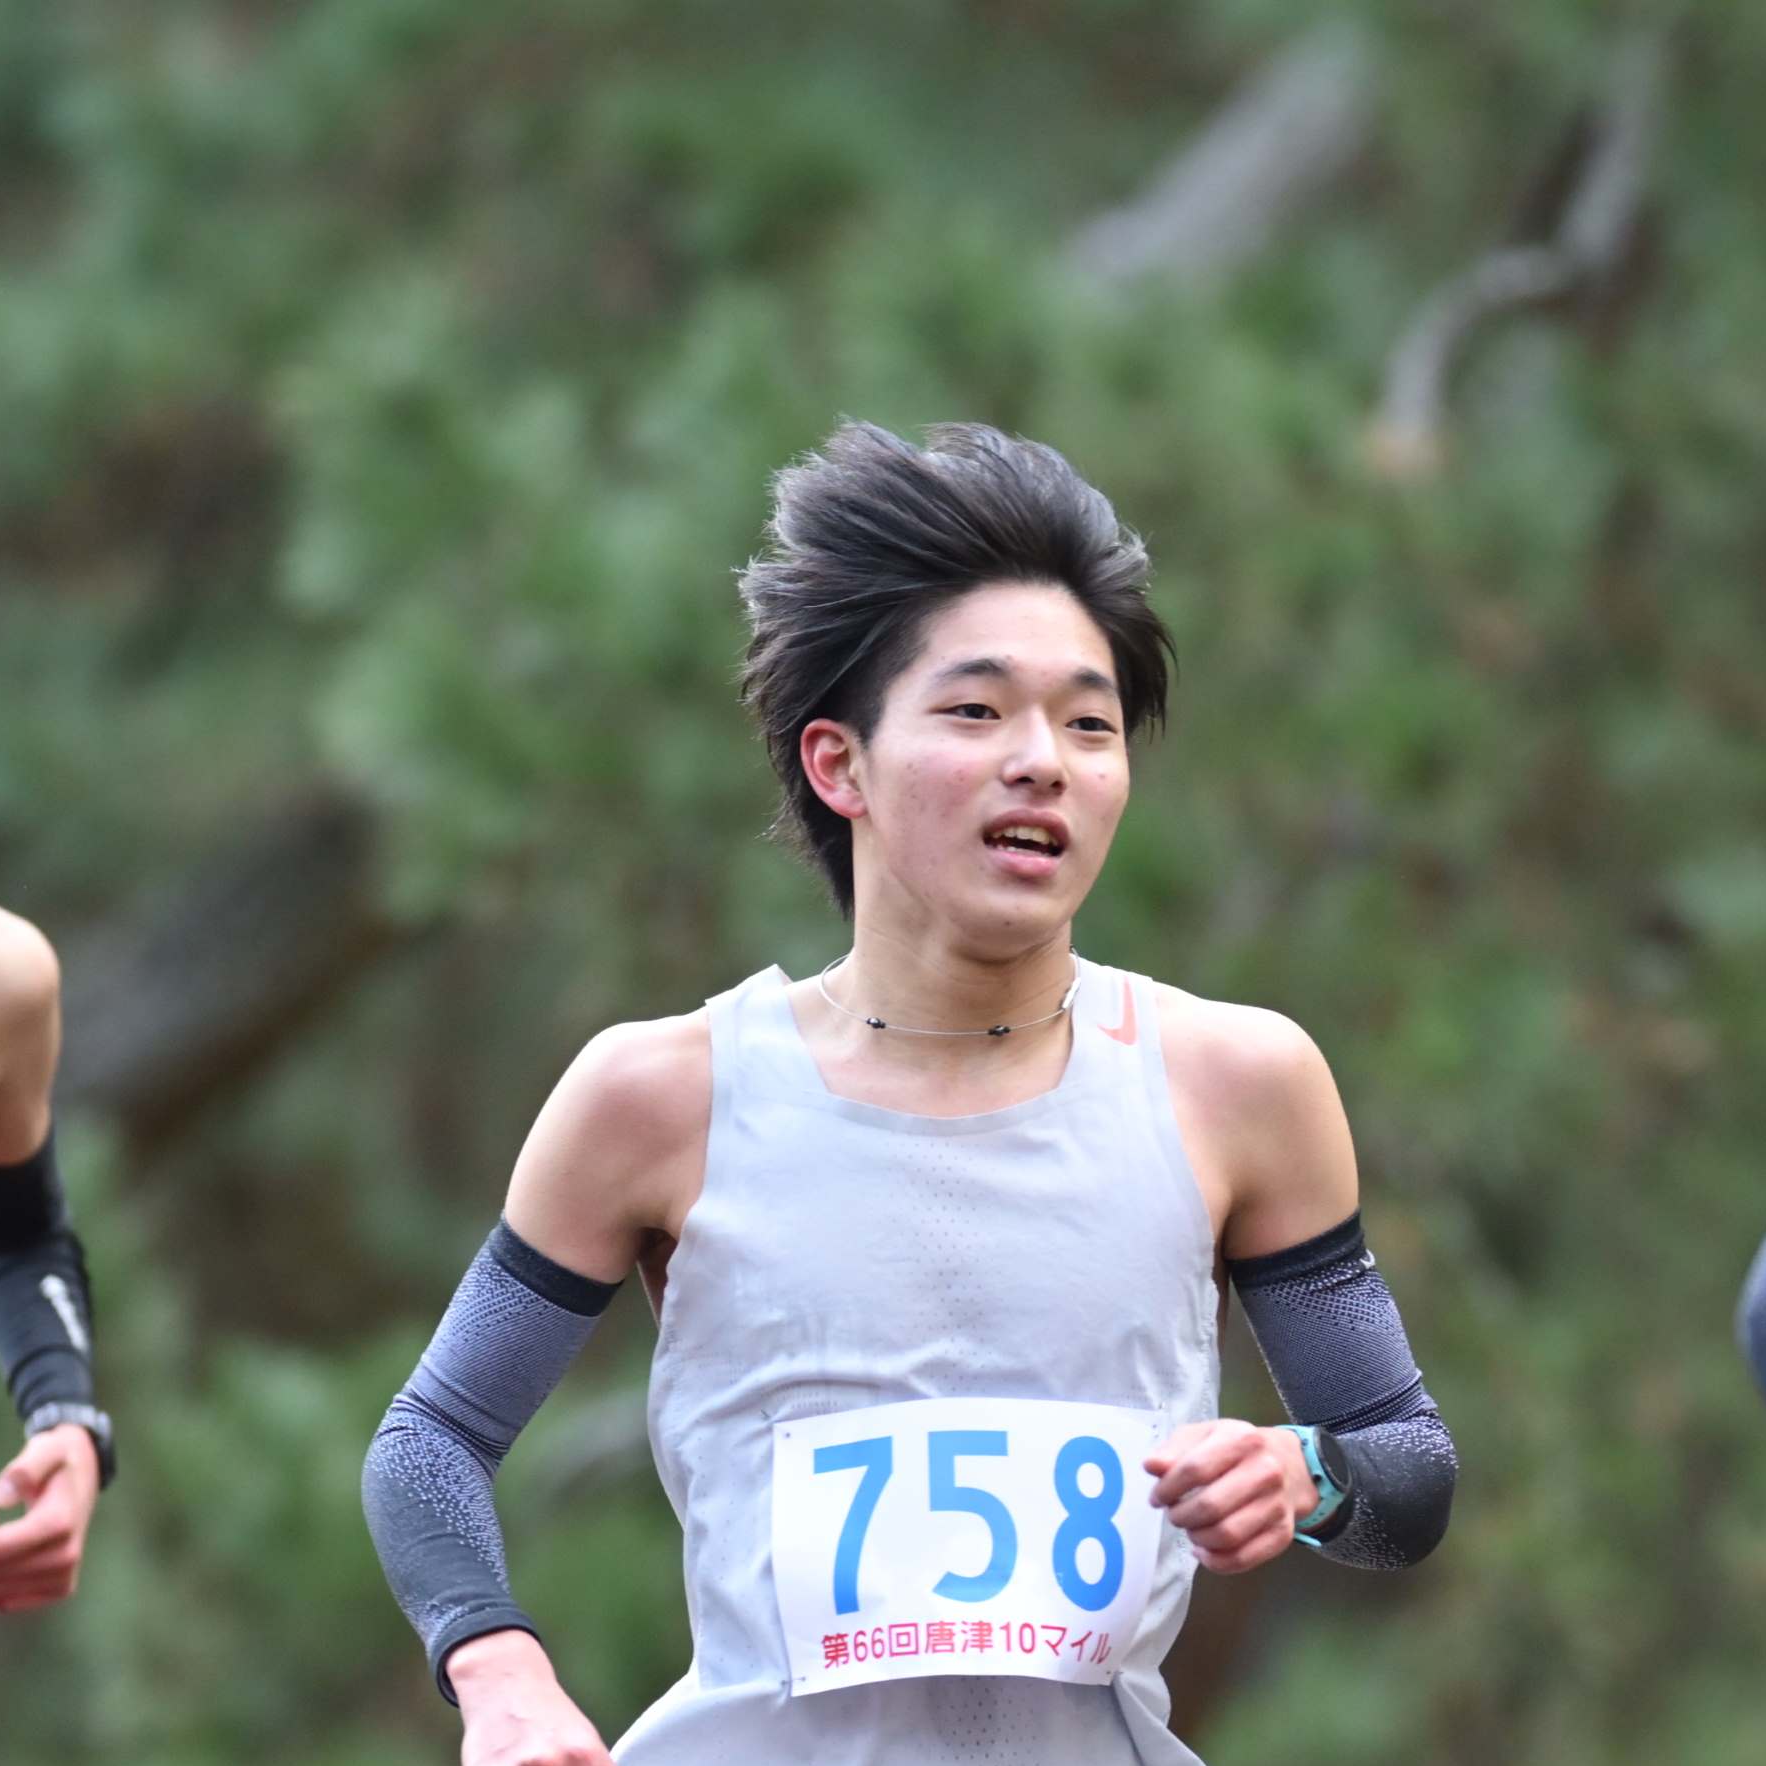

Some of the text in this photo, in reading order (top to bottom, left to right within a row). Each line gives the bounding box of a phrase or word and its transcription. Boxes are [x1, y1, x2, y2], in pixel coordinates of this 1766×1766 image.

[812, 1429, 1125, 1616] 758
[821, 1619, 1112, 1669] 第66回唐津10マイル
